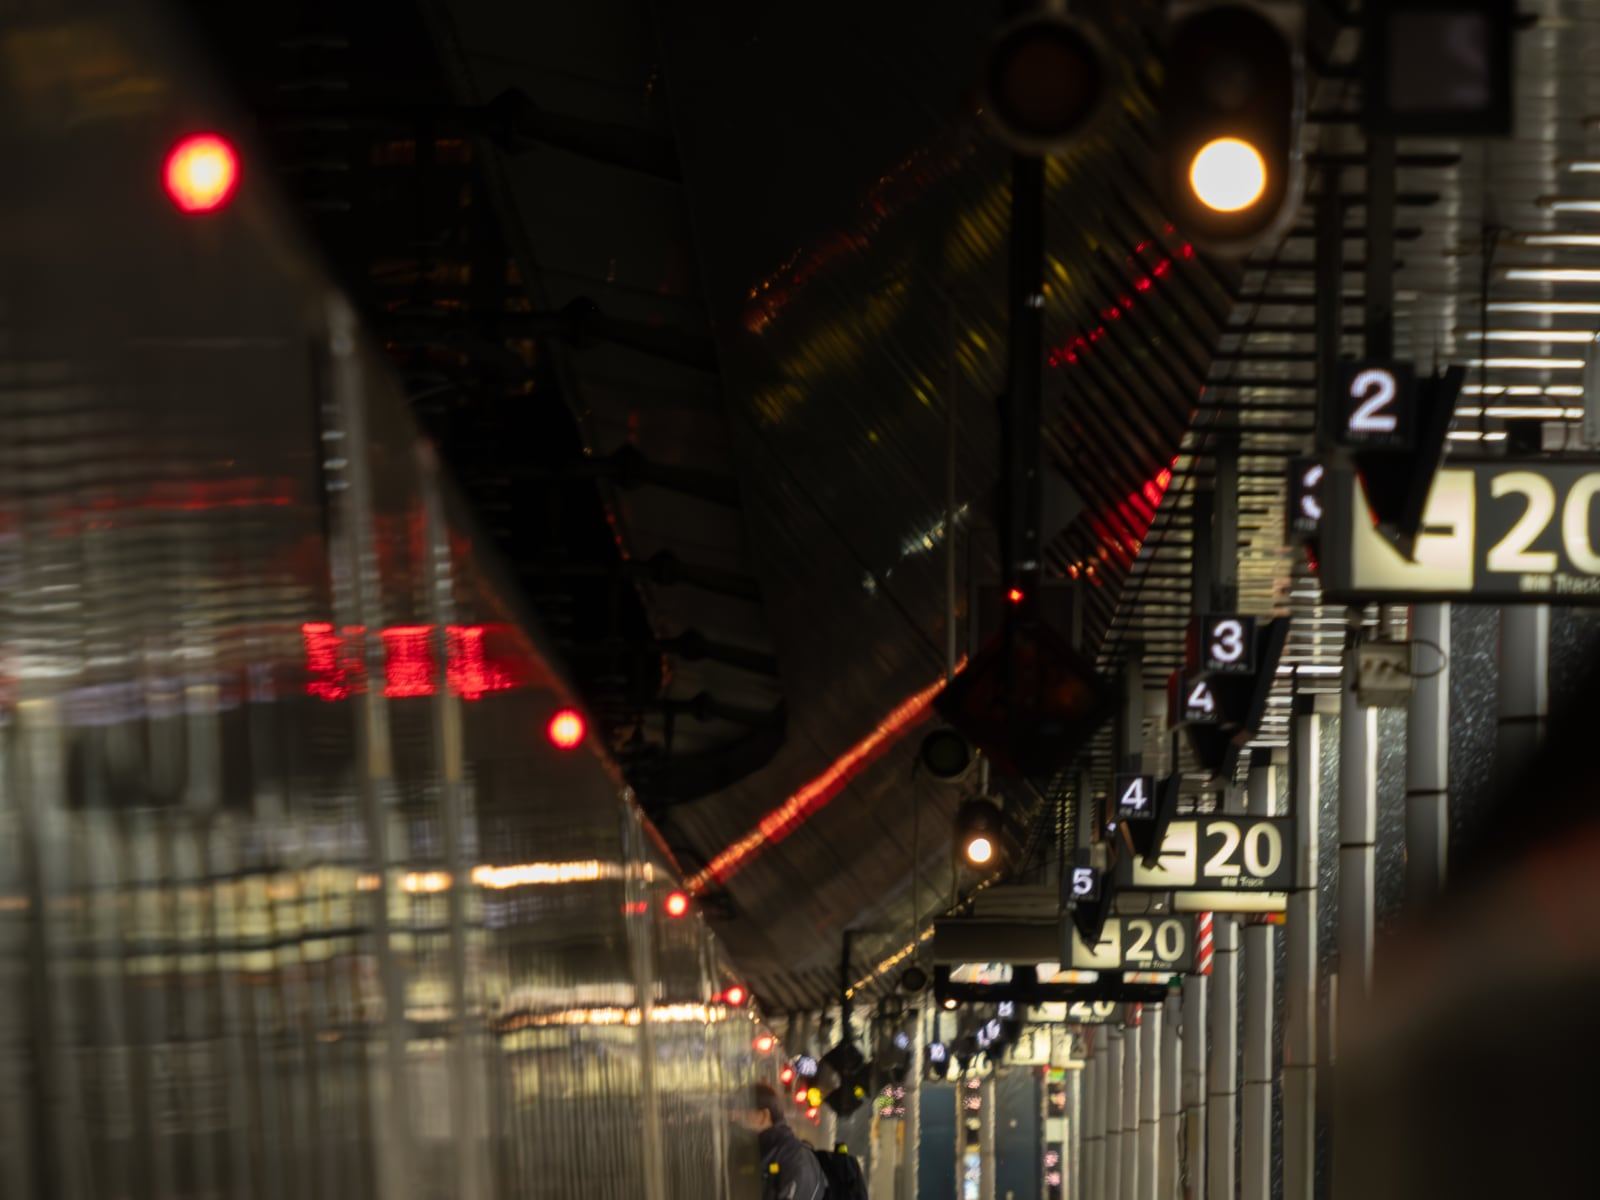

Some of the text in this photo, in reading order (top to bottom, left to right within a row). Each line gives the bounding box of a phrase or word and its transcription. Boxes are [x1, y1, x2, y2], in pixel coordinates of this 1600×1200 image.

[1350, 369, 1396, 431] 2
[1487, 471, 1600, 574] 20
[1212, 620, 1243, 662] 3
[1187, 682, 1214, 712] 4
[1121, 778, 1147, 810] 4
[1204, 821, 1282, 878] 20
[1073, 867, 1093, 895] 5
[1125, 919, 1185, 962] 20
